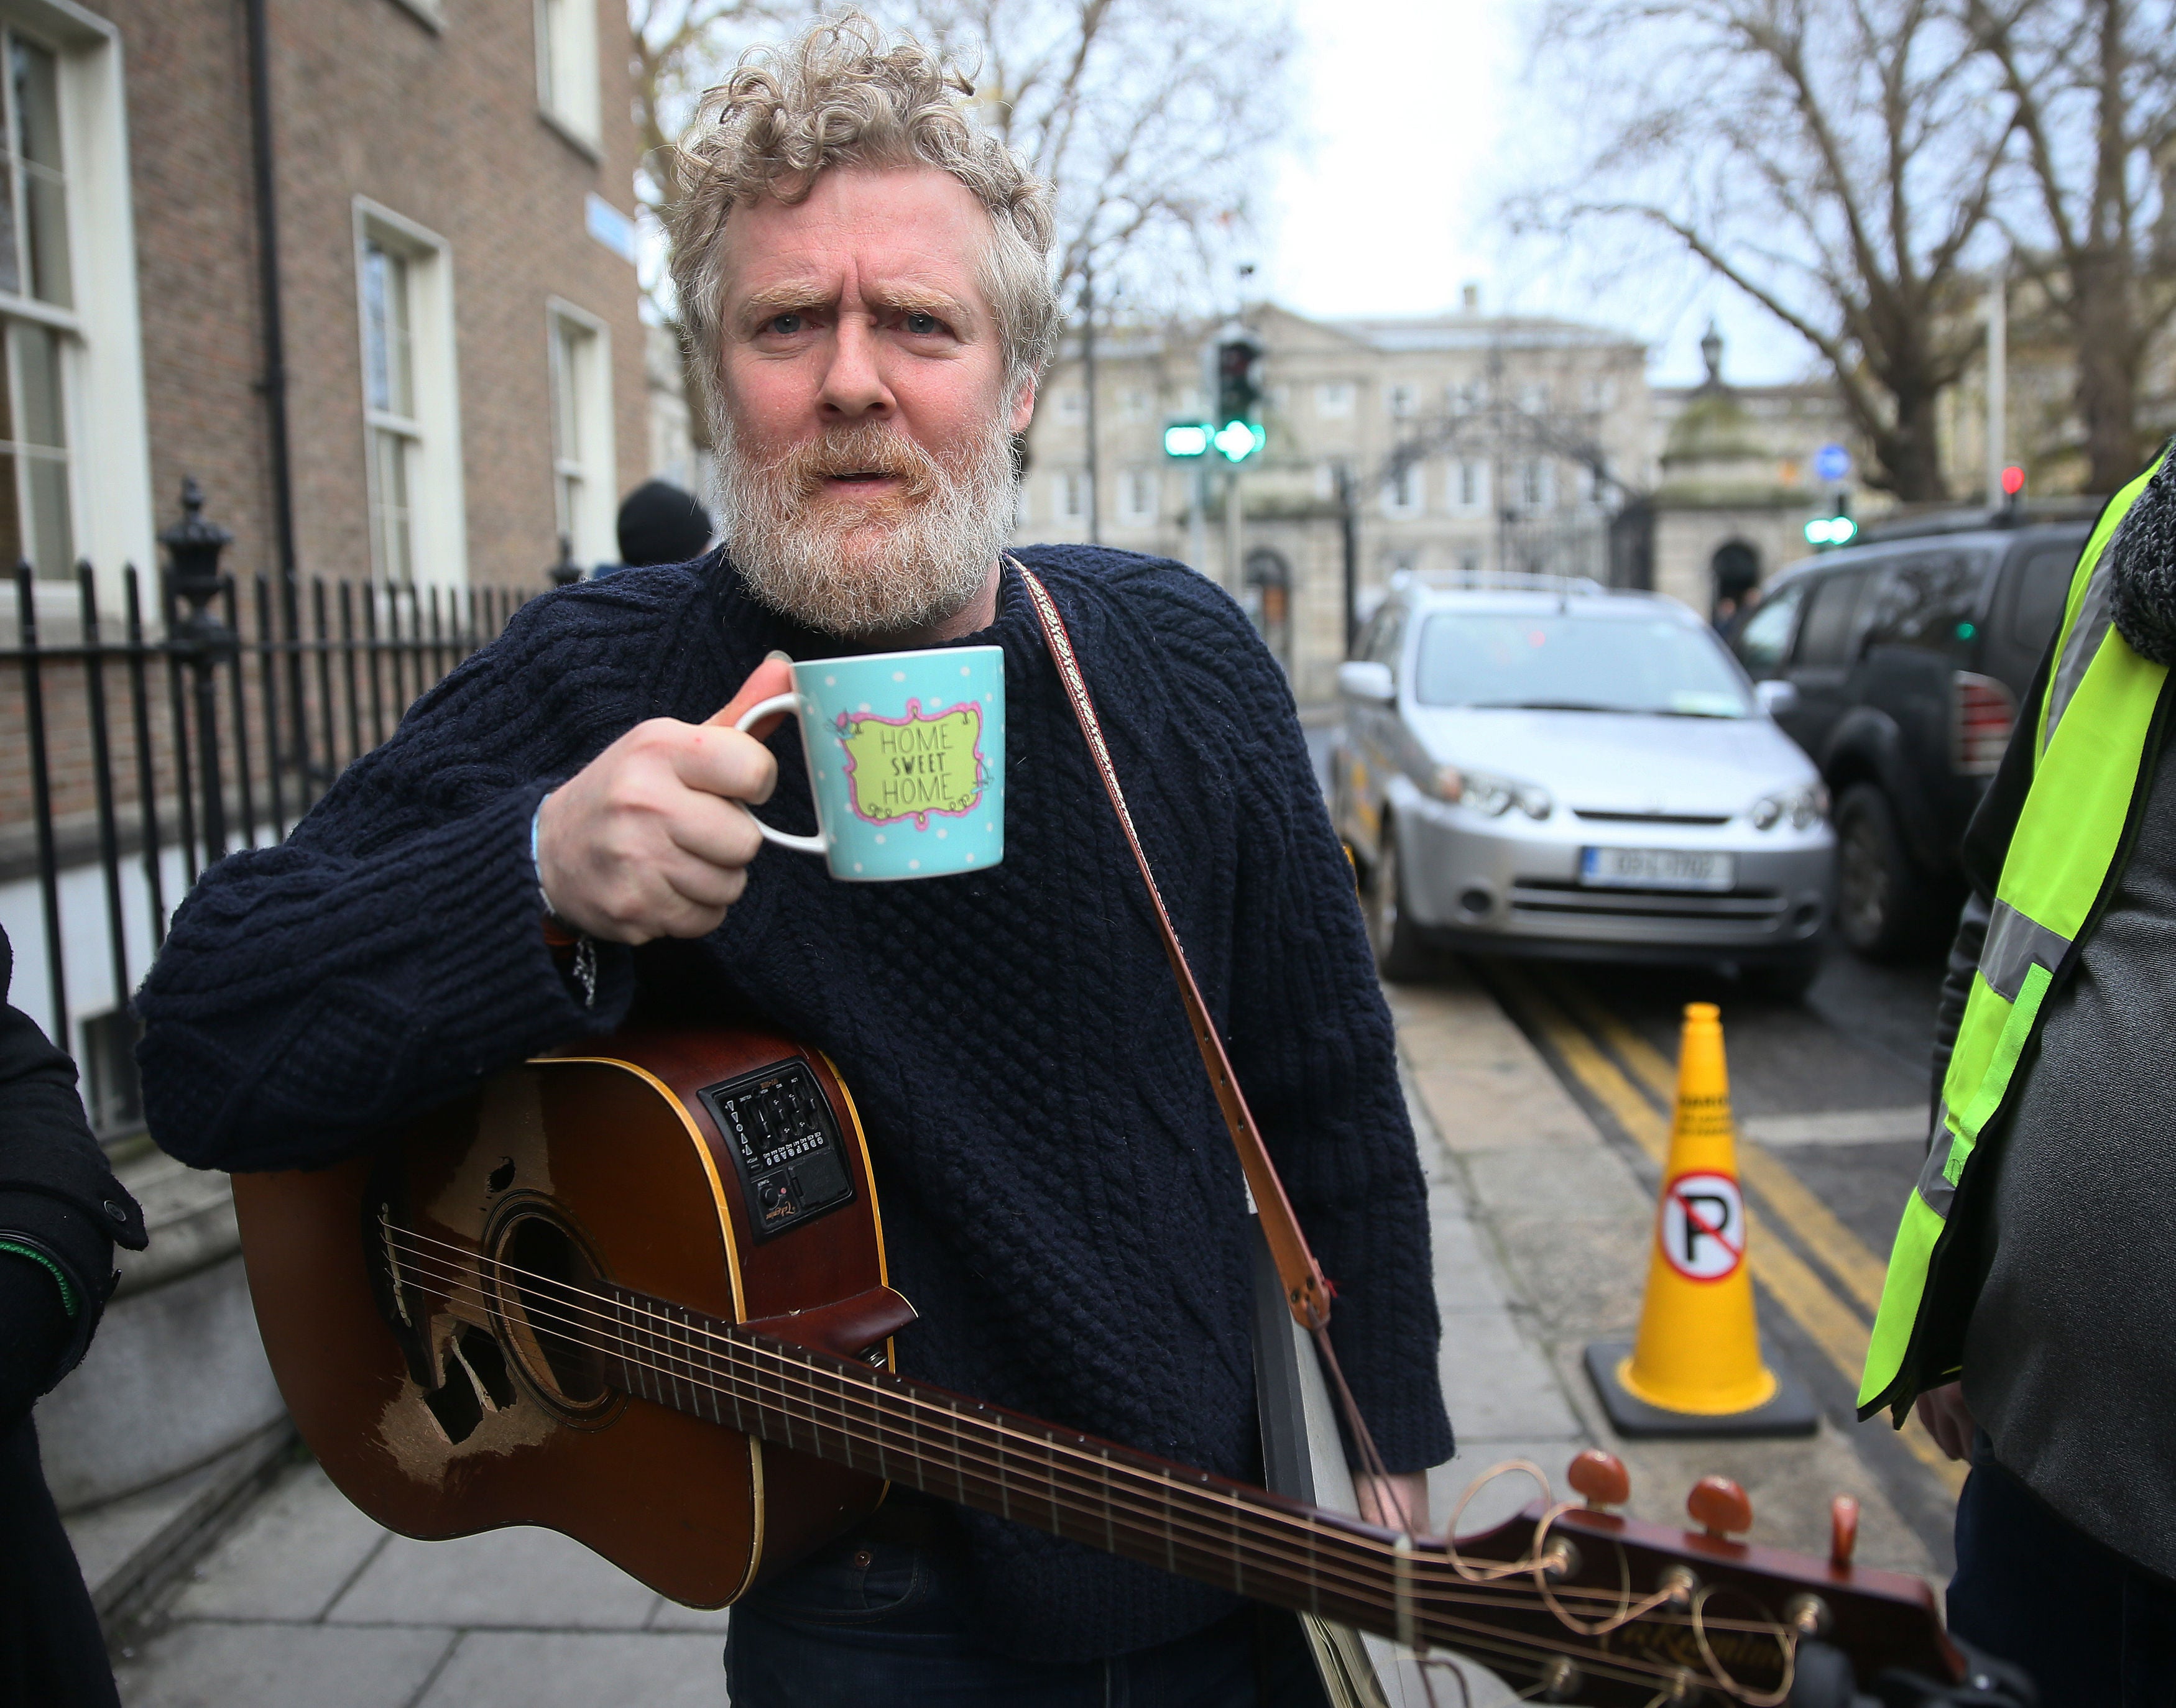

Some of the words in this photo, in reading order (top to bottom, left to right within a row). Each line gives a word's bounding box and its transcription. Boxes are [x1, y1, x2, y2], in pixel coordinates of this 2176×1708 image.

[880, 724, 954, 754] HOME
[892, 752, 946, 776] SWEET
[882, 773, 954, 804] HOME
[1683, 1195, 1728, 1262] P
